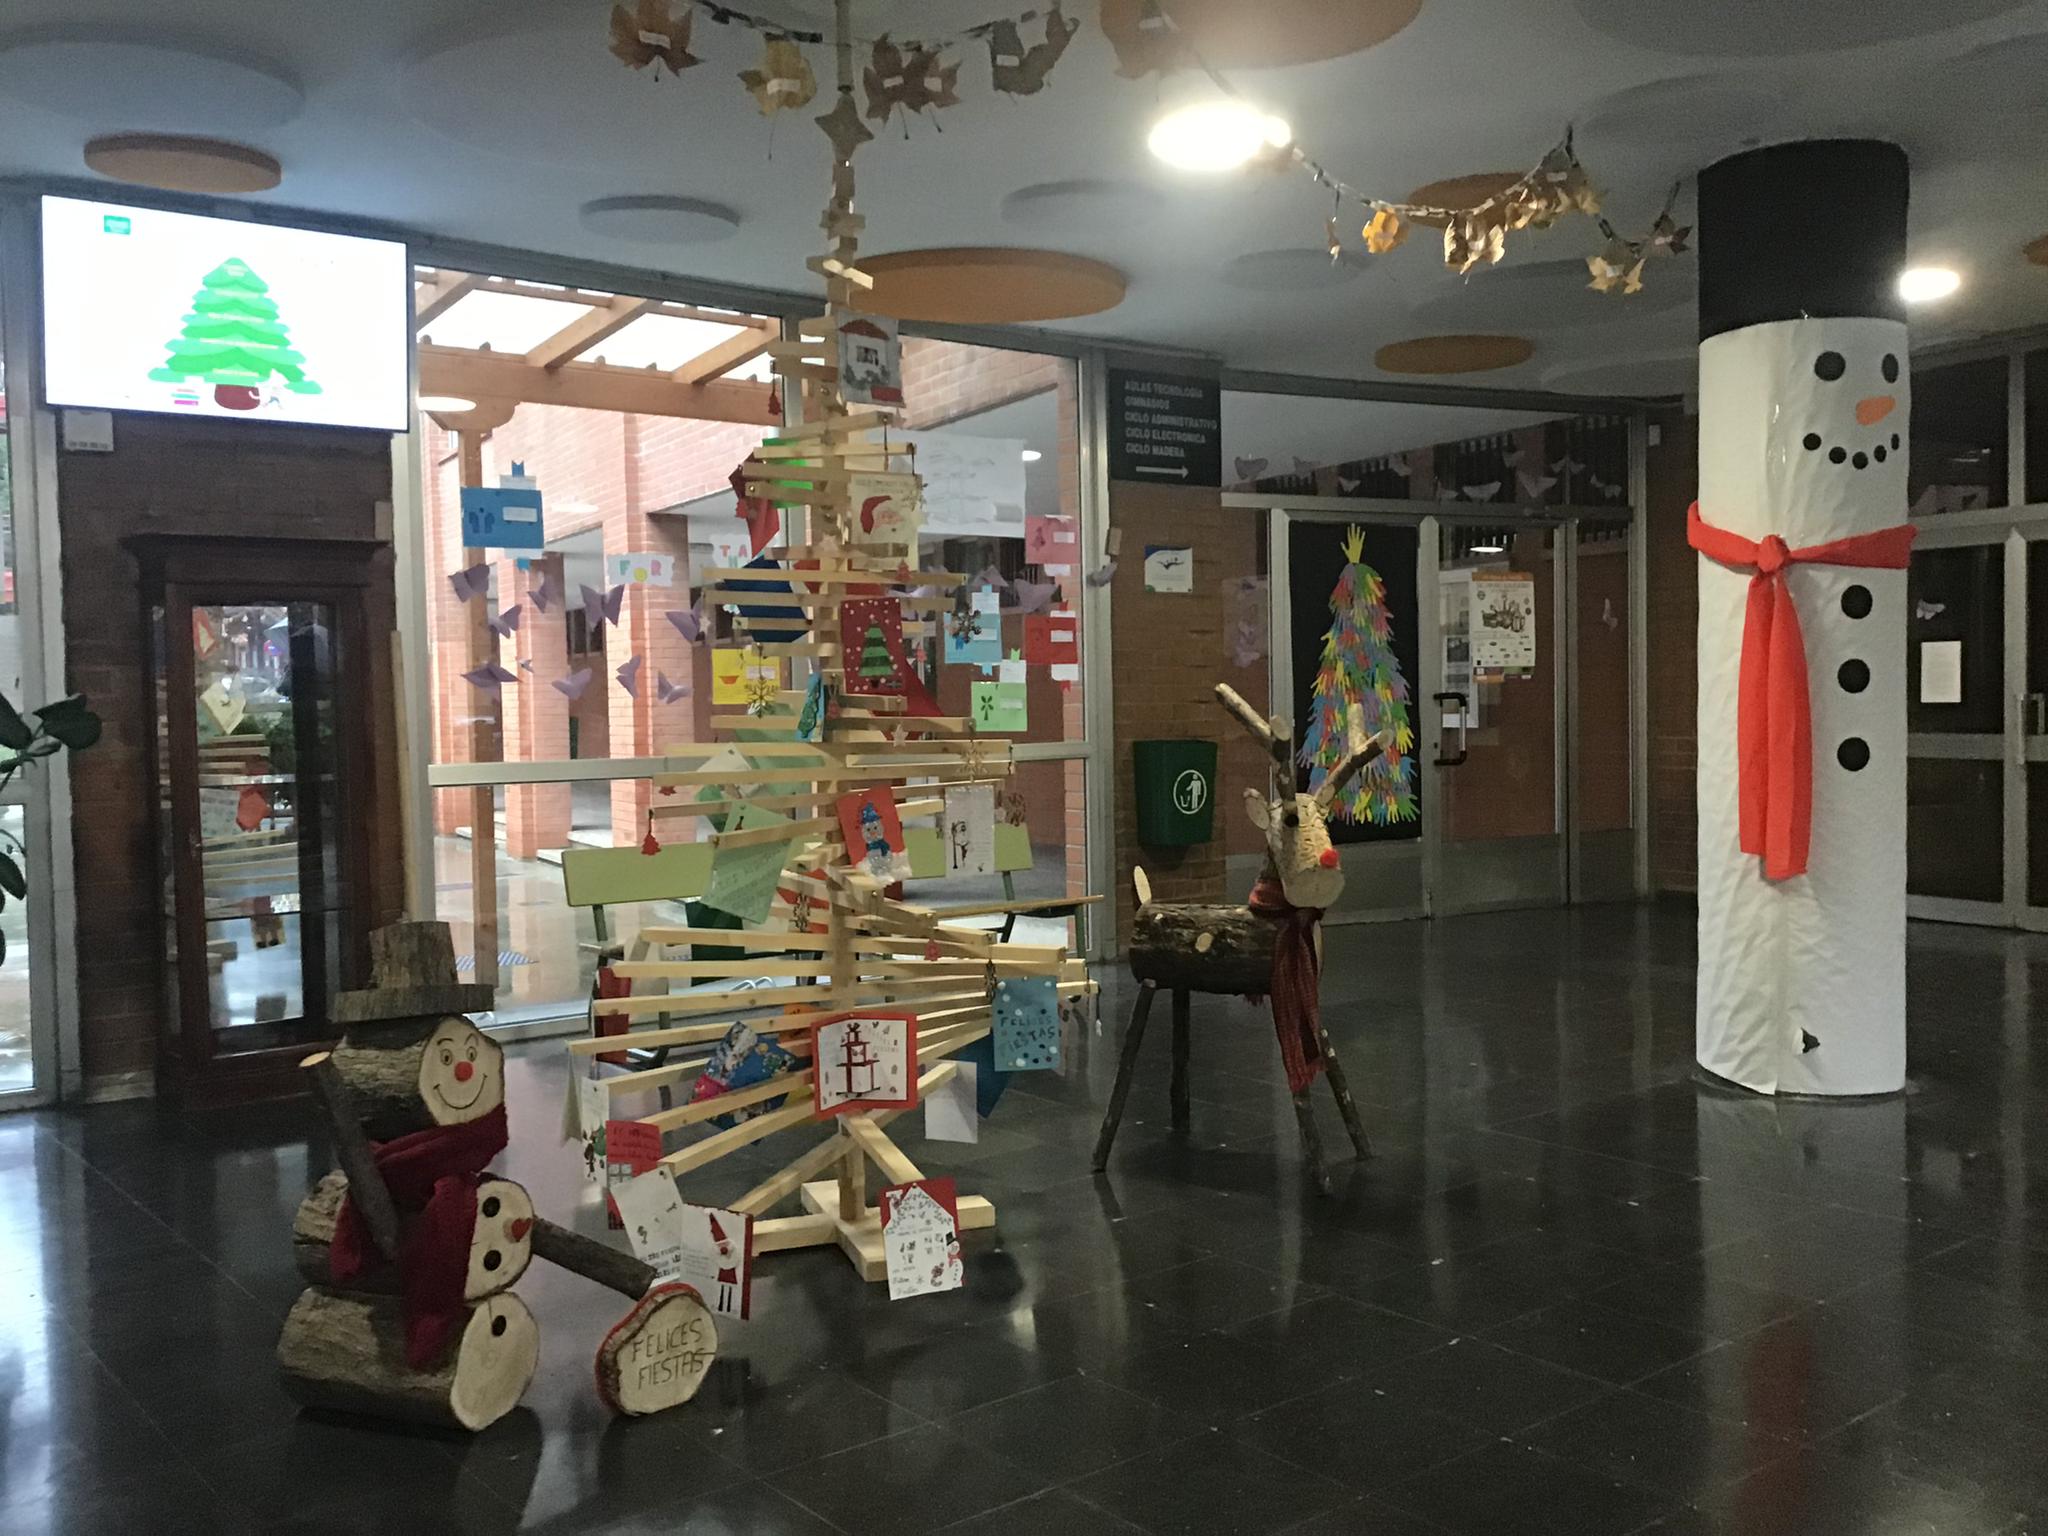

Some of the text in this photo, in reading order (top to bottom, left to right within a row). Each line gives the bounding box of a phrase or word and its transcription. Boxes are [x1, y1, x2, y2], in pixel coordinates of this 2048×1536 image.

[1124, 380, 1152, 393] AULAS
[1124, 411, 1218, 430] CICLO ADMINISTRATIVO
[1125, 426, 1150, 439] CICLO
[1125, 442, 1185, 458] CICLO MADERA
[631, 1318, 703, 1363] FELICES
[637, 1347, 706, 1390] FIESTAS
